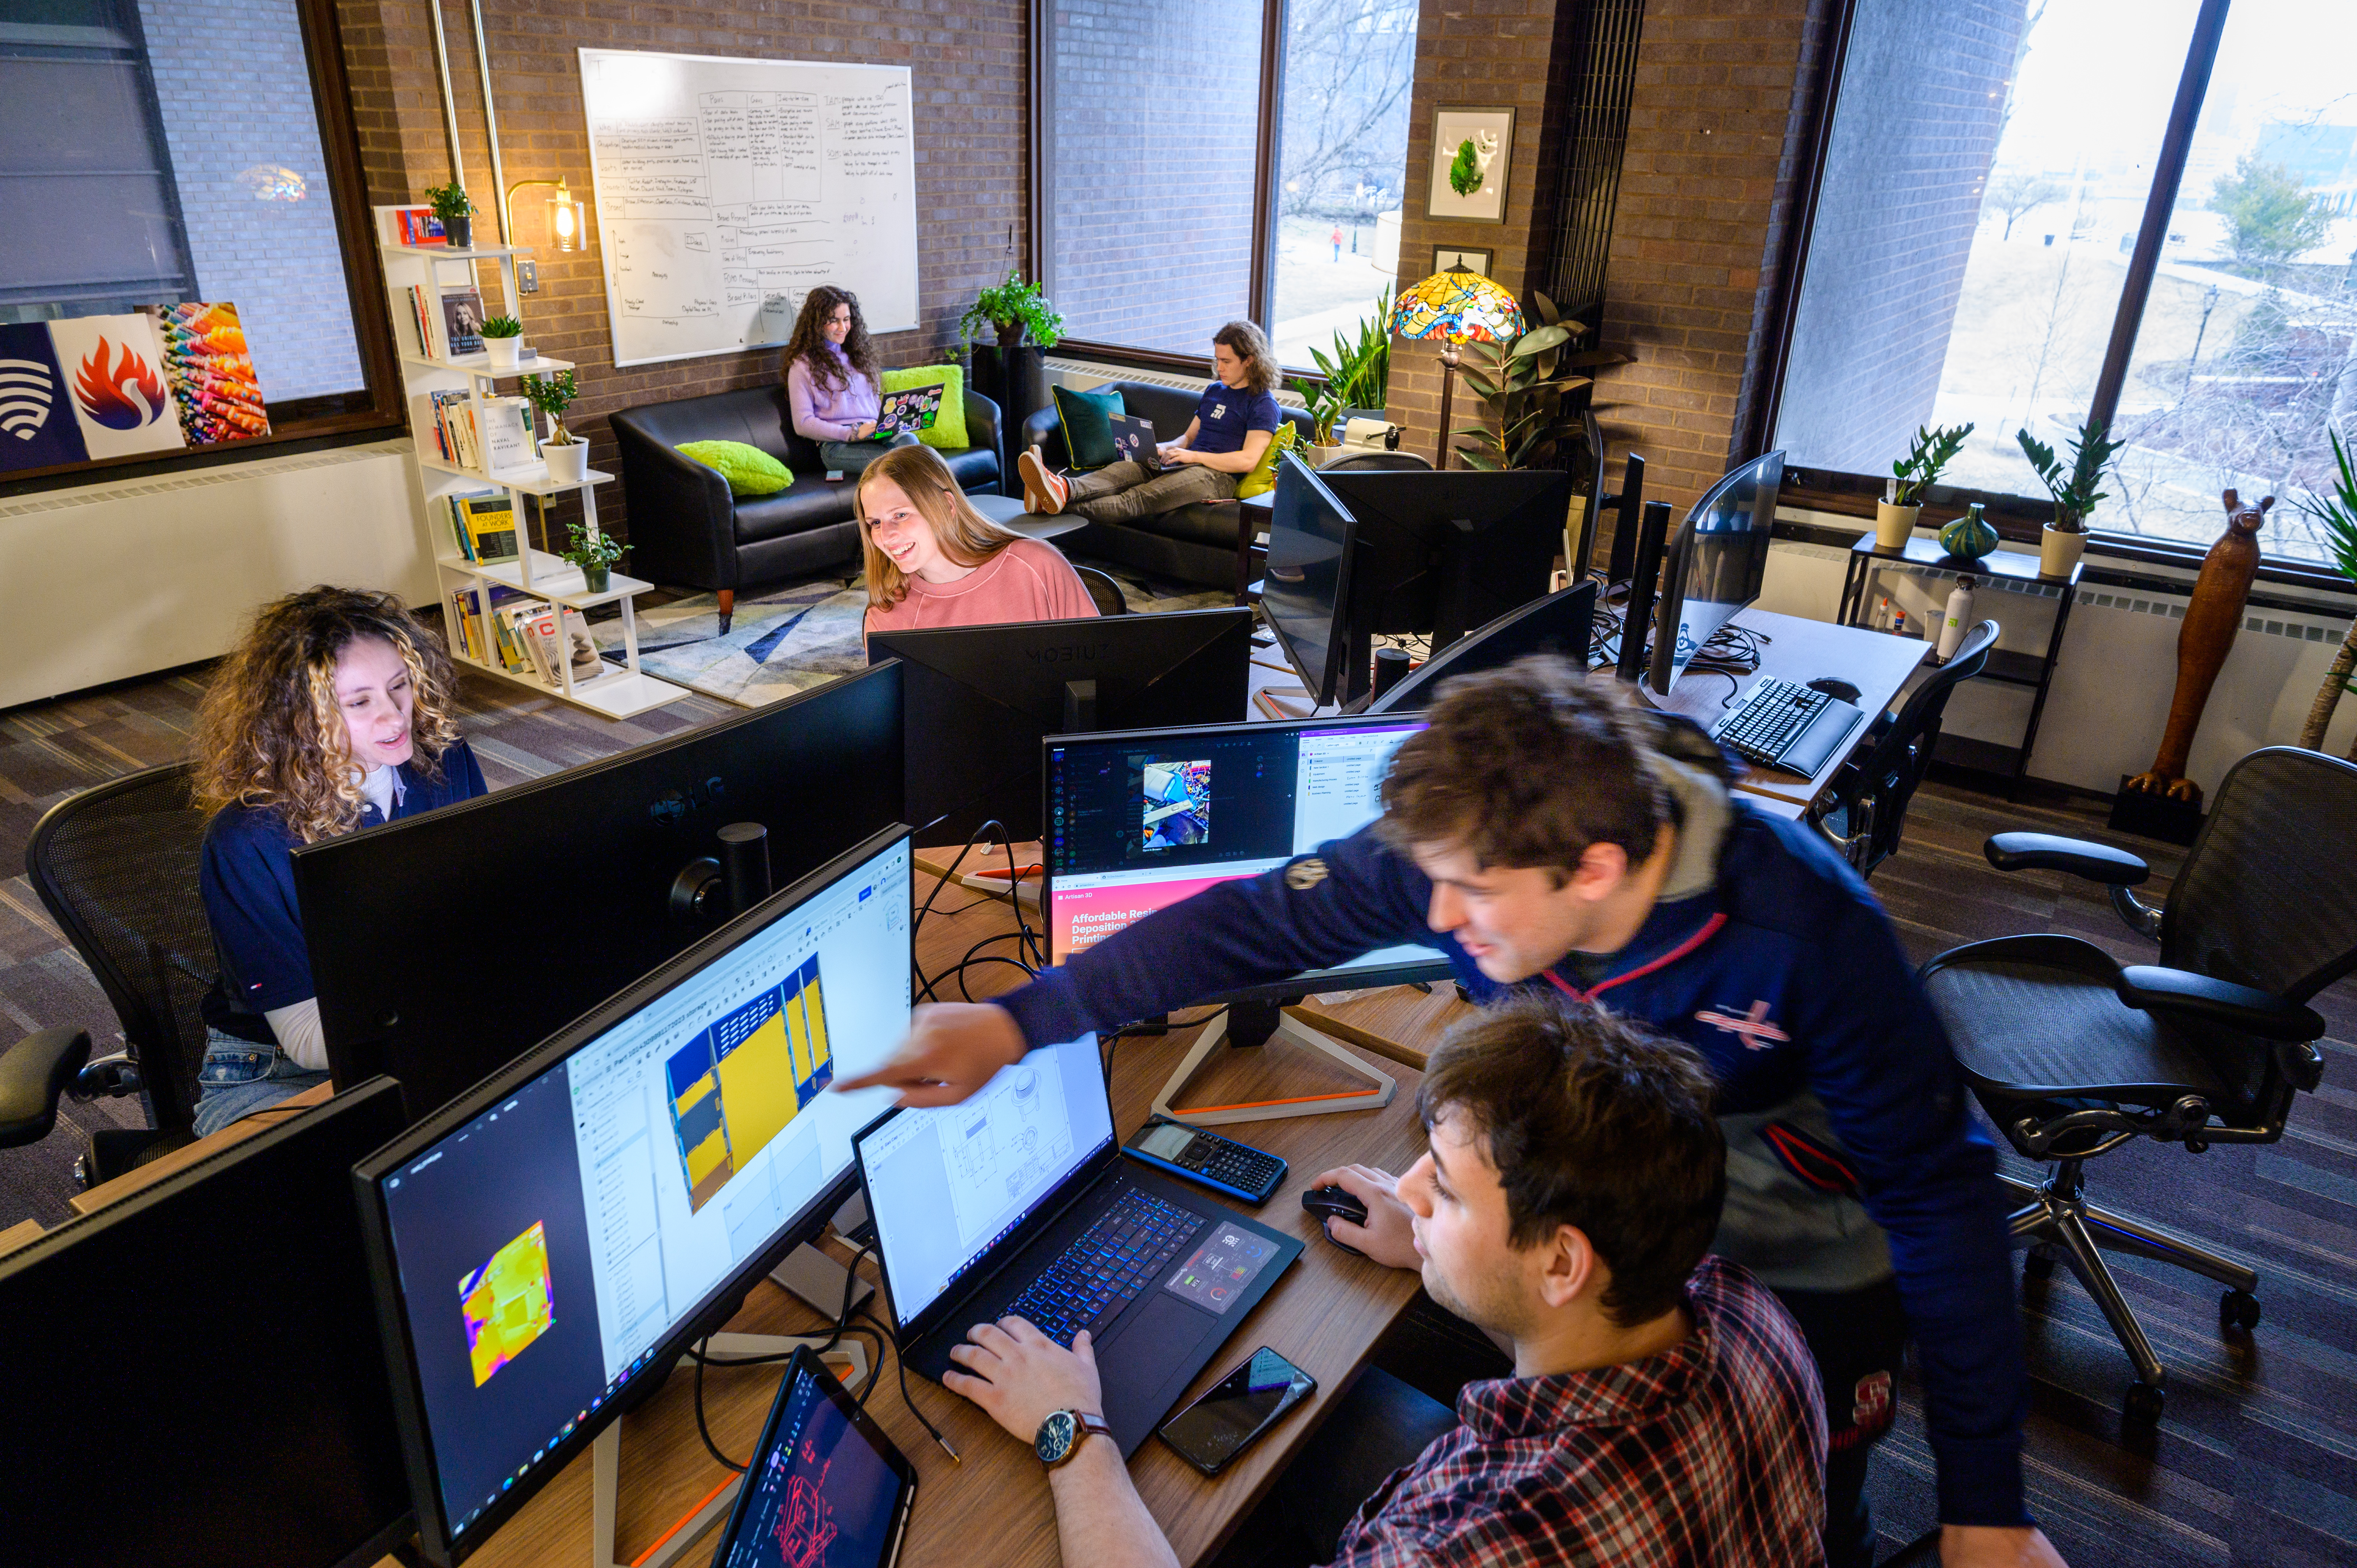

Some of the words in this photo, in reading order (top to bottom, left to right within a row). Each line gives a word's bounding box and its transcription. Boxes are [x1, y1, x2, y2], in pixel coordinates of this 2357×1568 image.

[605, 201, 623, 212] Brand
[717, 213, 729, 221] Brand
[731, 212, 747, 222] Promise
[721, 235, 735, 243] Mission
[727, 293, 742, 301] Brand
[682, 305, 694, 314] Digital
[488, 422, 519, 430] ALMANACK
[476, 512, 511, 522] FOUNDERS
[1072, 910, 1127, 923] Affordable
[1072, 922, 1127, 935] Deposition
[613, 1055, 628, 1067] Part
[686, 1000, 708, 1019] storage
[1191, 1278, 1201, 1287] RTX
